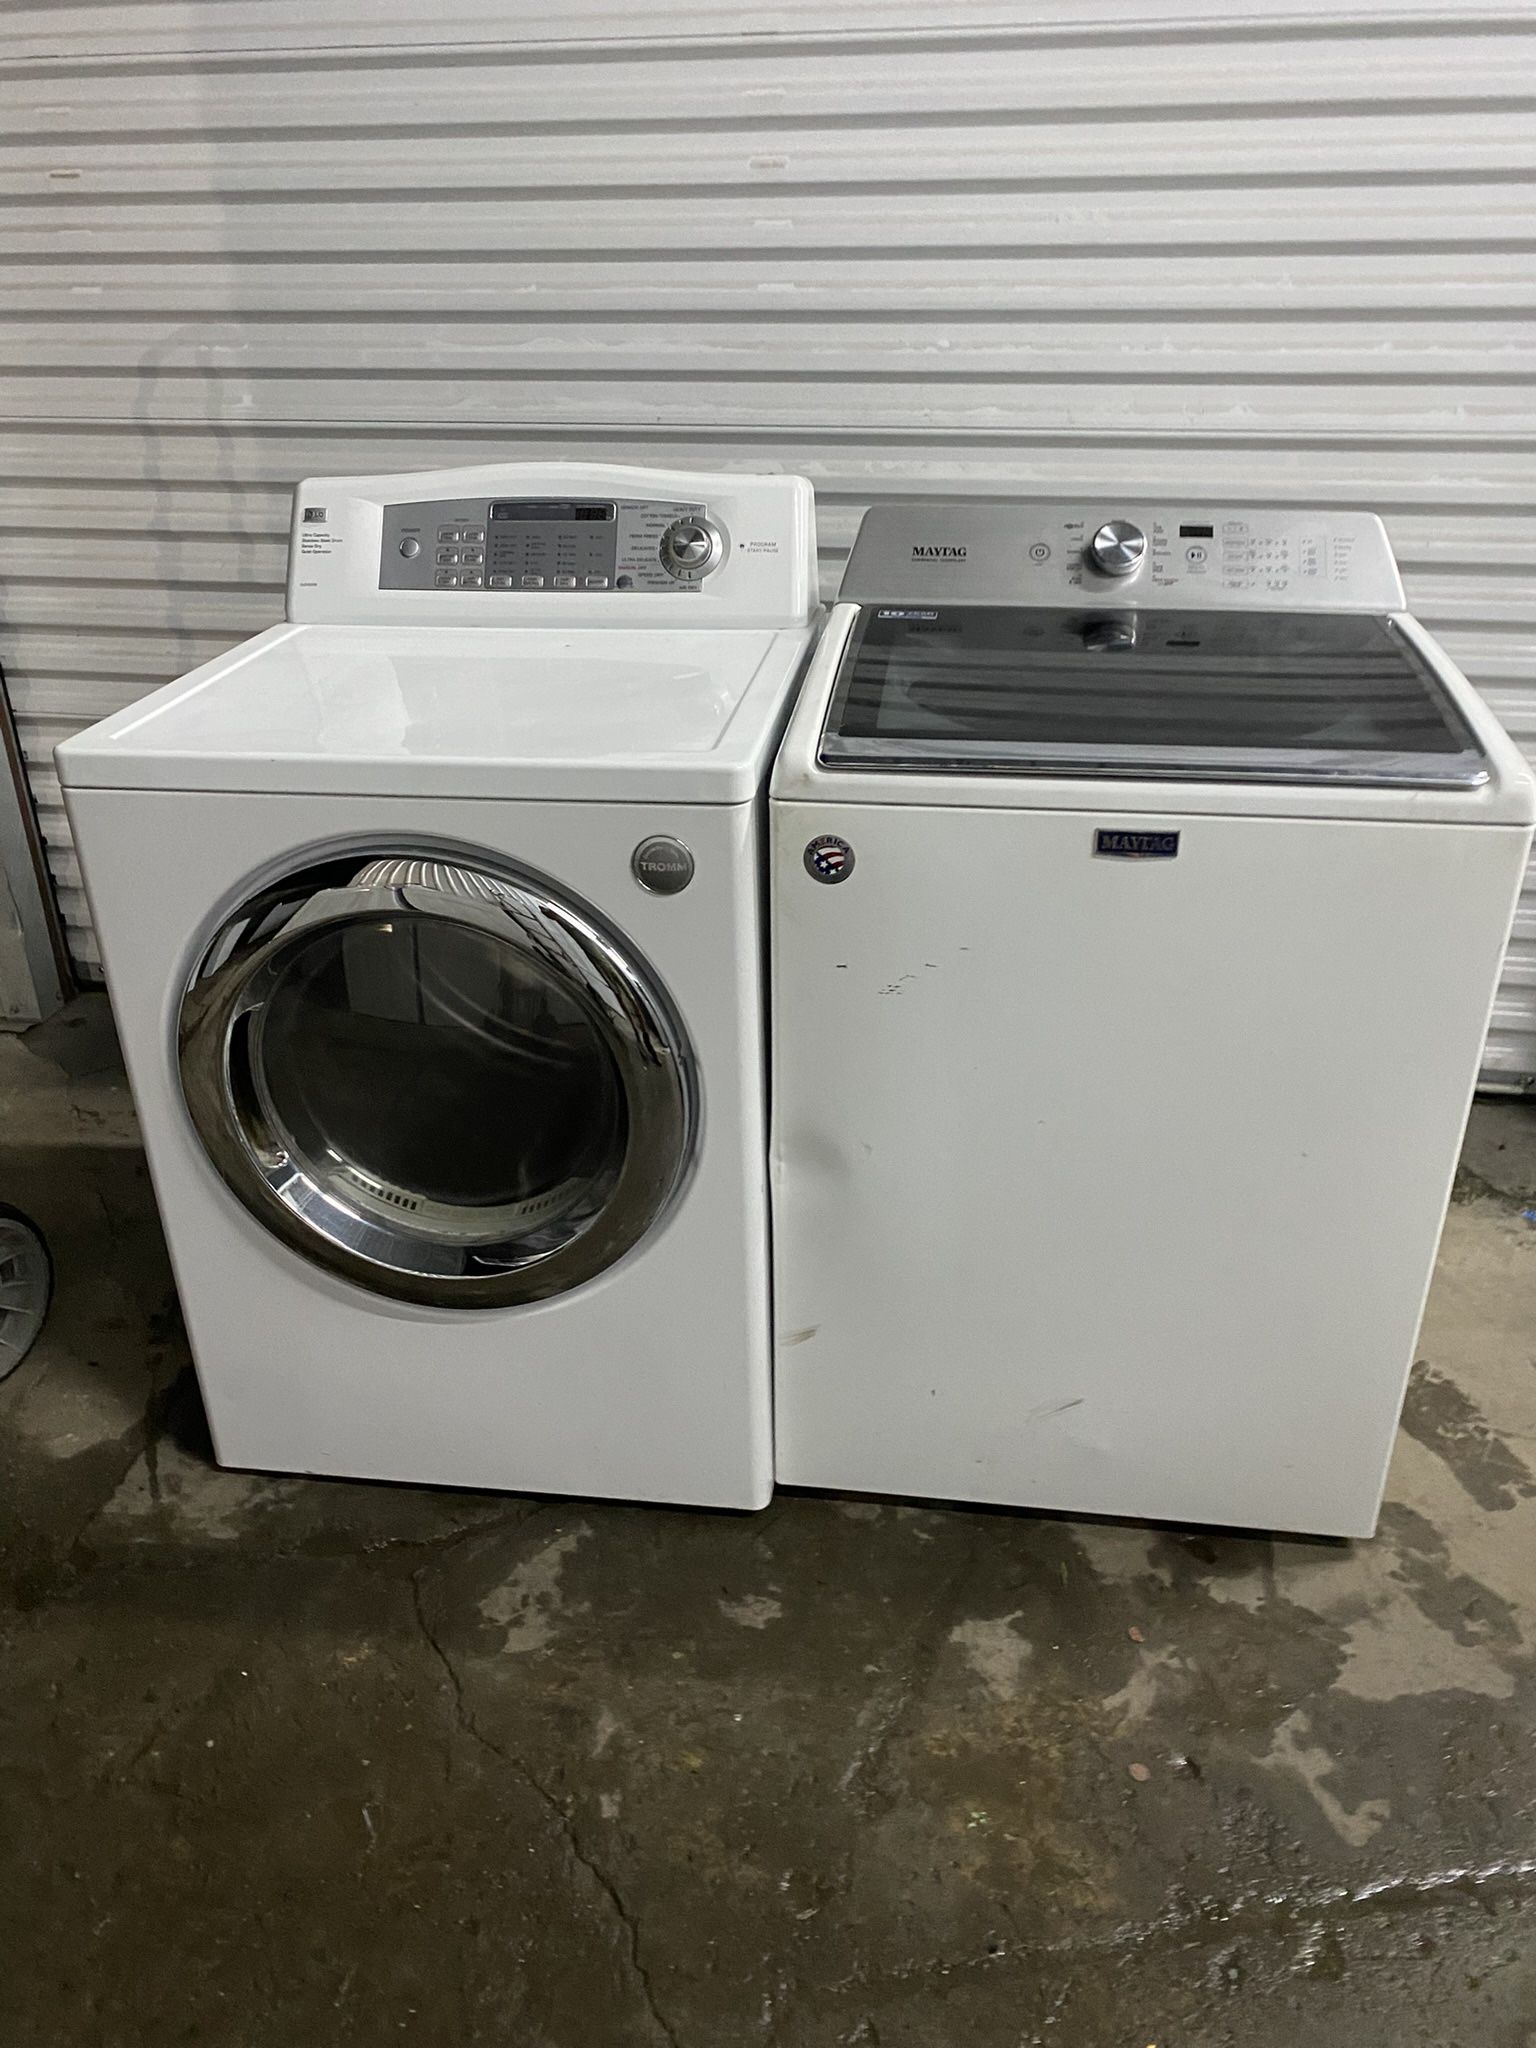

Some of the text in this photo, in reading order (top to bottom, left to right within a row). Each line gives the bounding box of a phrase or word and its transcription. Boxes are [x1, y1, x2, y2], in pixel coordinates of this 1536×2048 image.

[912, 546, 967, 557] MAYTAG
[807, 837, 850, 855] AMERICA
[1101, 835, 1174, 851] MAYTAG
[640, 861, 688, 872] TROMM
